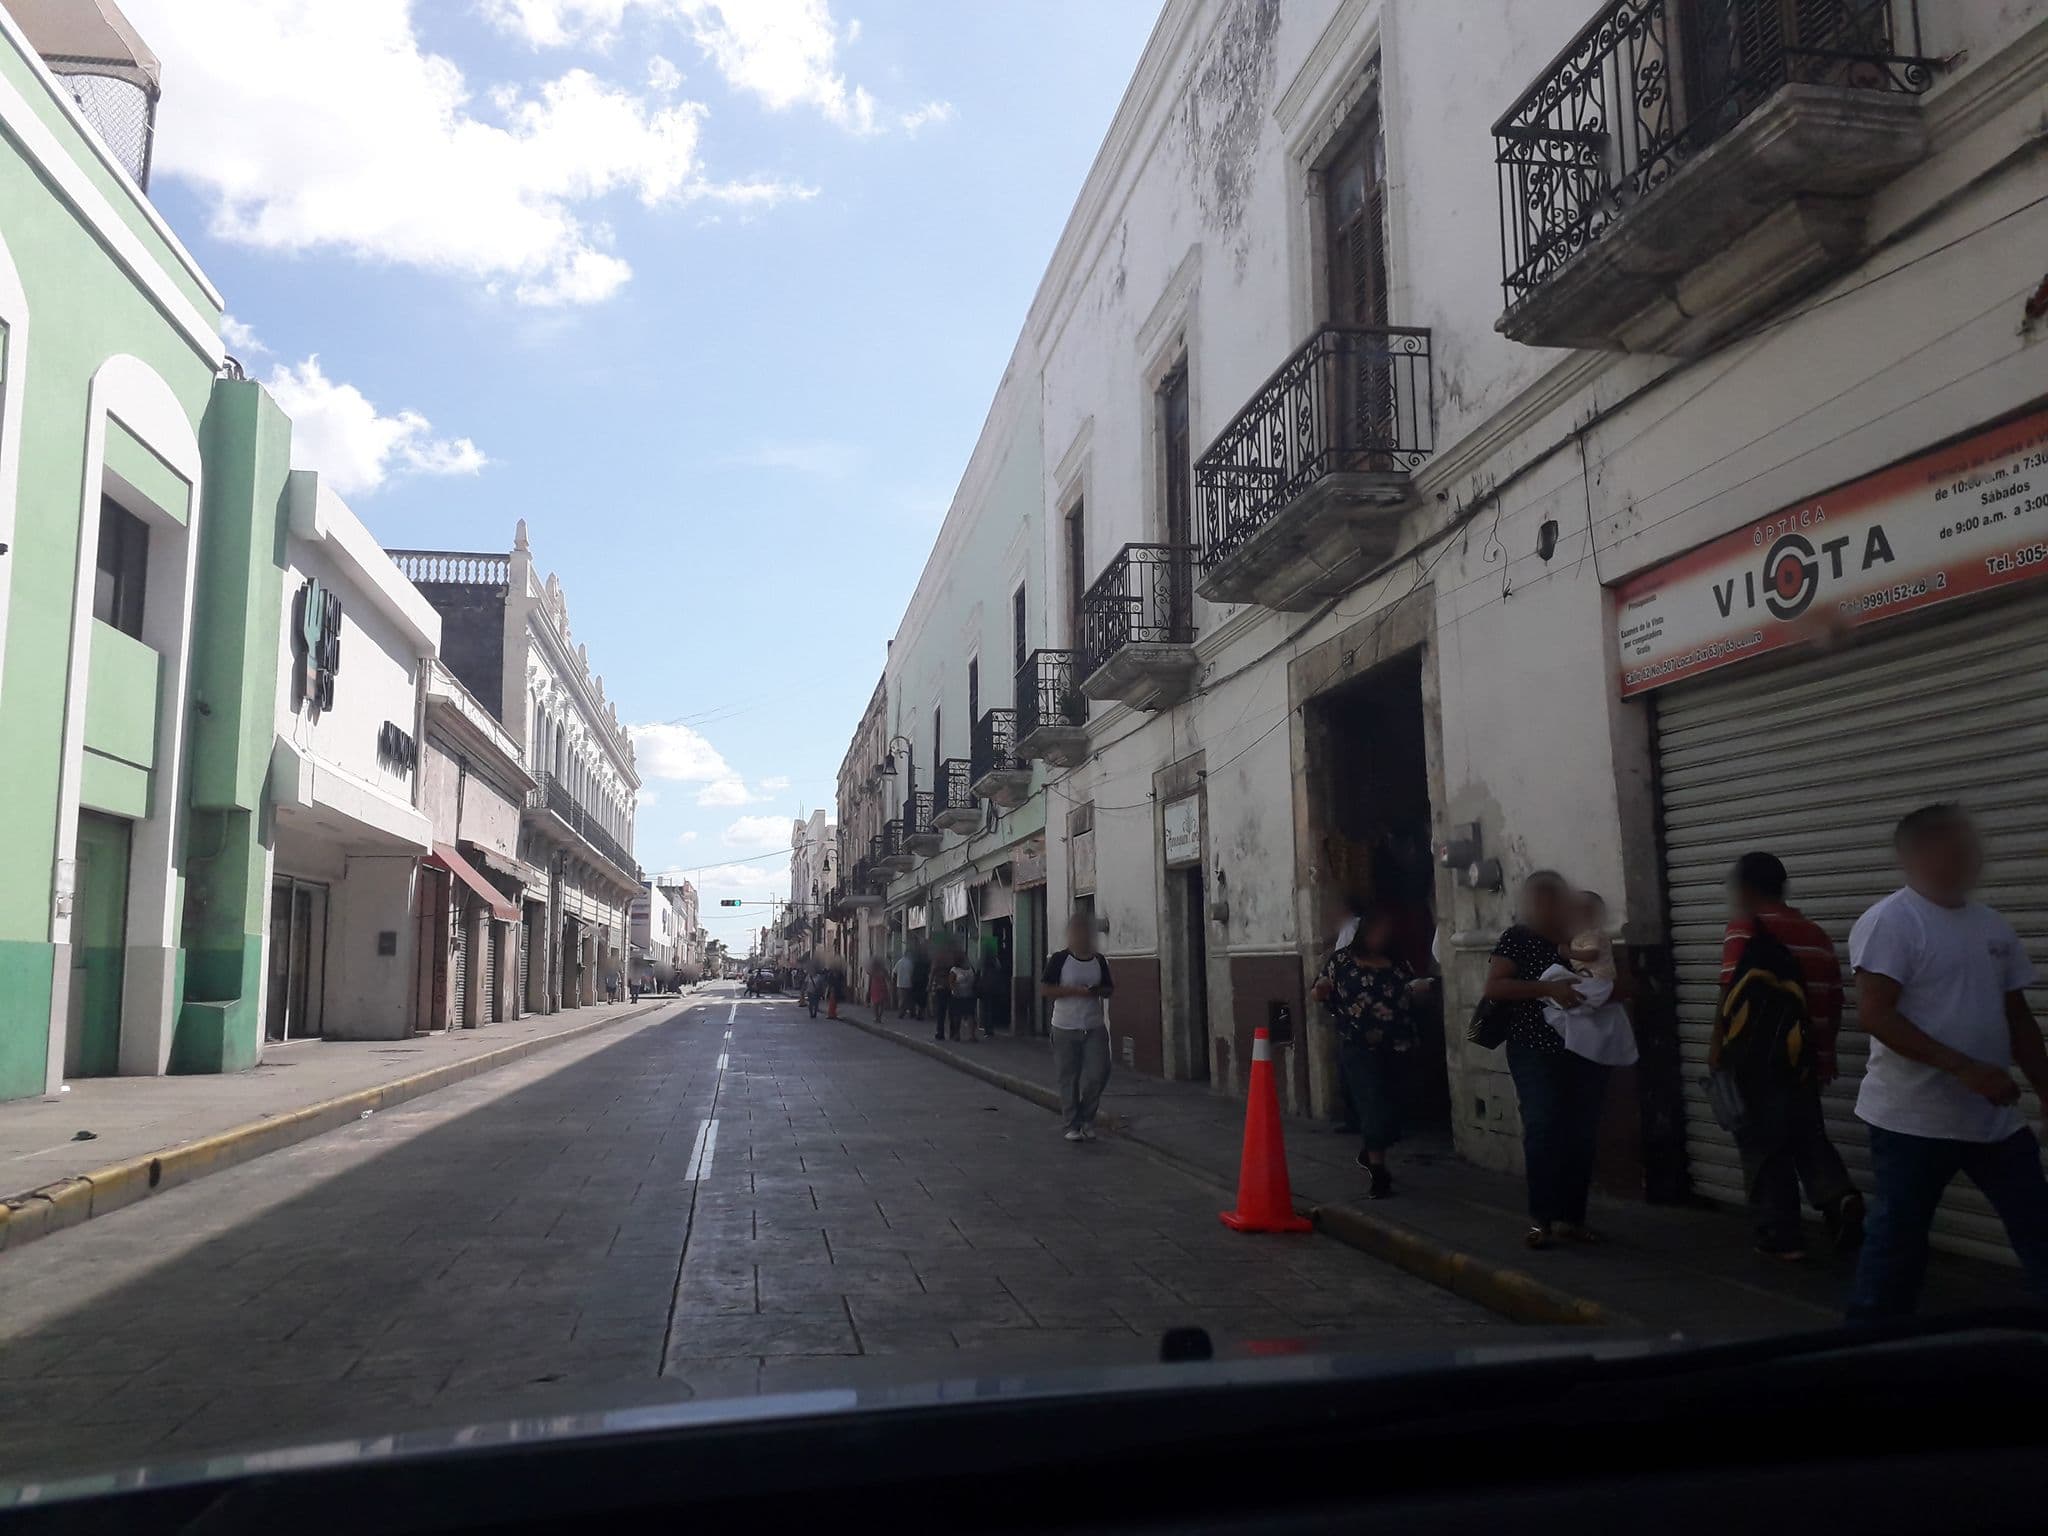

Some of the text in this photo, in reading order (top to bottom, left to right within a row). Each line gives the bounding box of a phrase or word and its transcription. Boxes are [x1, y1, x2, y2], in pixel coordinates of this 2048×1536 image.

[1935, 488, 1948, 501] de
[2013, 464, 2020, 474] a
[1981, 480, 2031, 506] Sábados
[1753, 504, 1825, 546] ÓPTICA
[1939, 527, 1953, 540] de
[1955, 516, 1980, 534] 9:00
[1983, 512, 2007, 526] a.m.
[2014, 506, 2021, 516] a
[1986, 554, 2014, 575] Tel.
